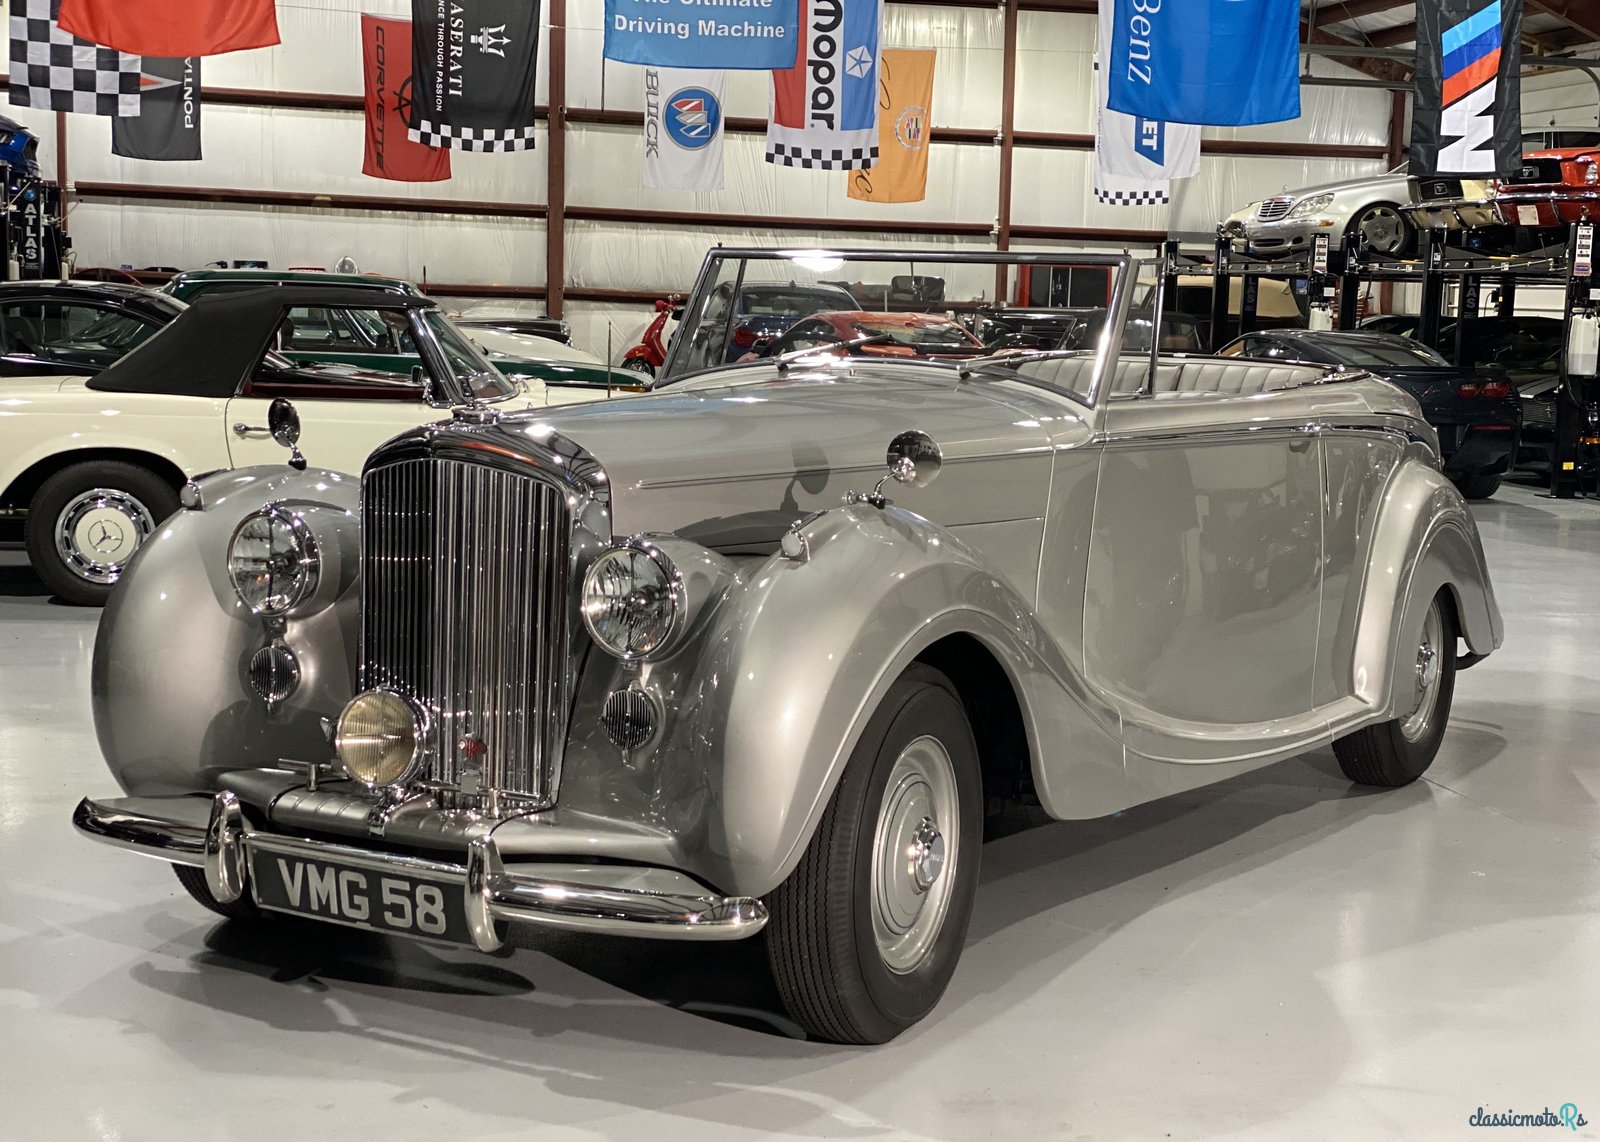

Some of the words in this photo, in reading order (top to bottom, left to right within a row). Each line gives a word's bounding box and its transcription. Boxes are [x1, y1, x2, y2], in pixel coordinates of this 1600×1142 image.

[436, 22, 445, 68] THROUGH
[614, 14, 690, 39] Driving
[698, 19, 785, 38] Machine
[1127, 0, 1162, 85] Benz
[376, 25, 385, 171] CORVETTE
[435, 70, 445, 112] PASSION
[645, 68, 659, 159] BUICK
[1142, 118, 1158, 151] ET
[24, 203, 38, 260] ATLAS
[277, 858, 369, 920] VMG
[381, 878, 446, 935] 58
